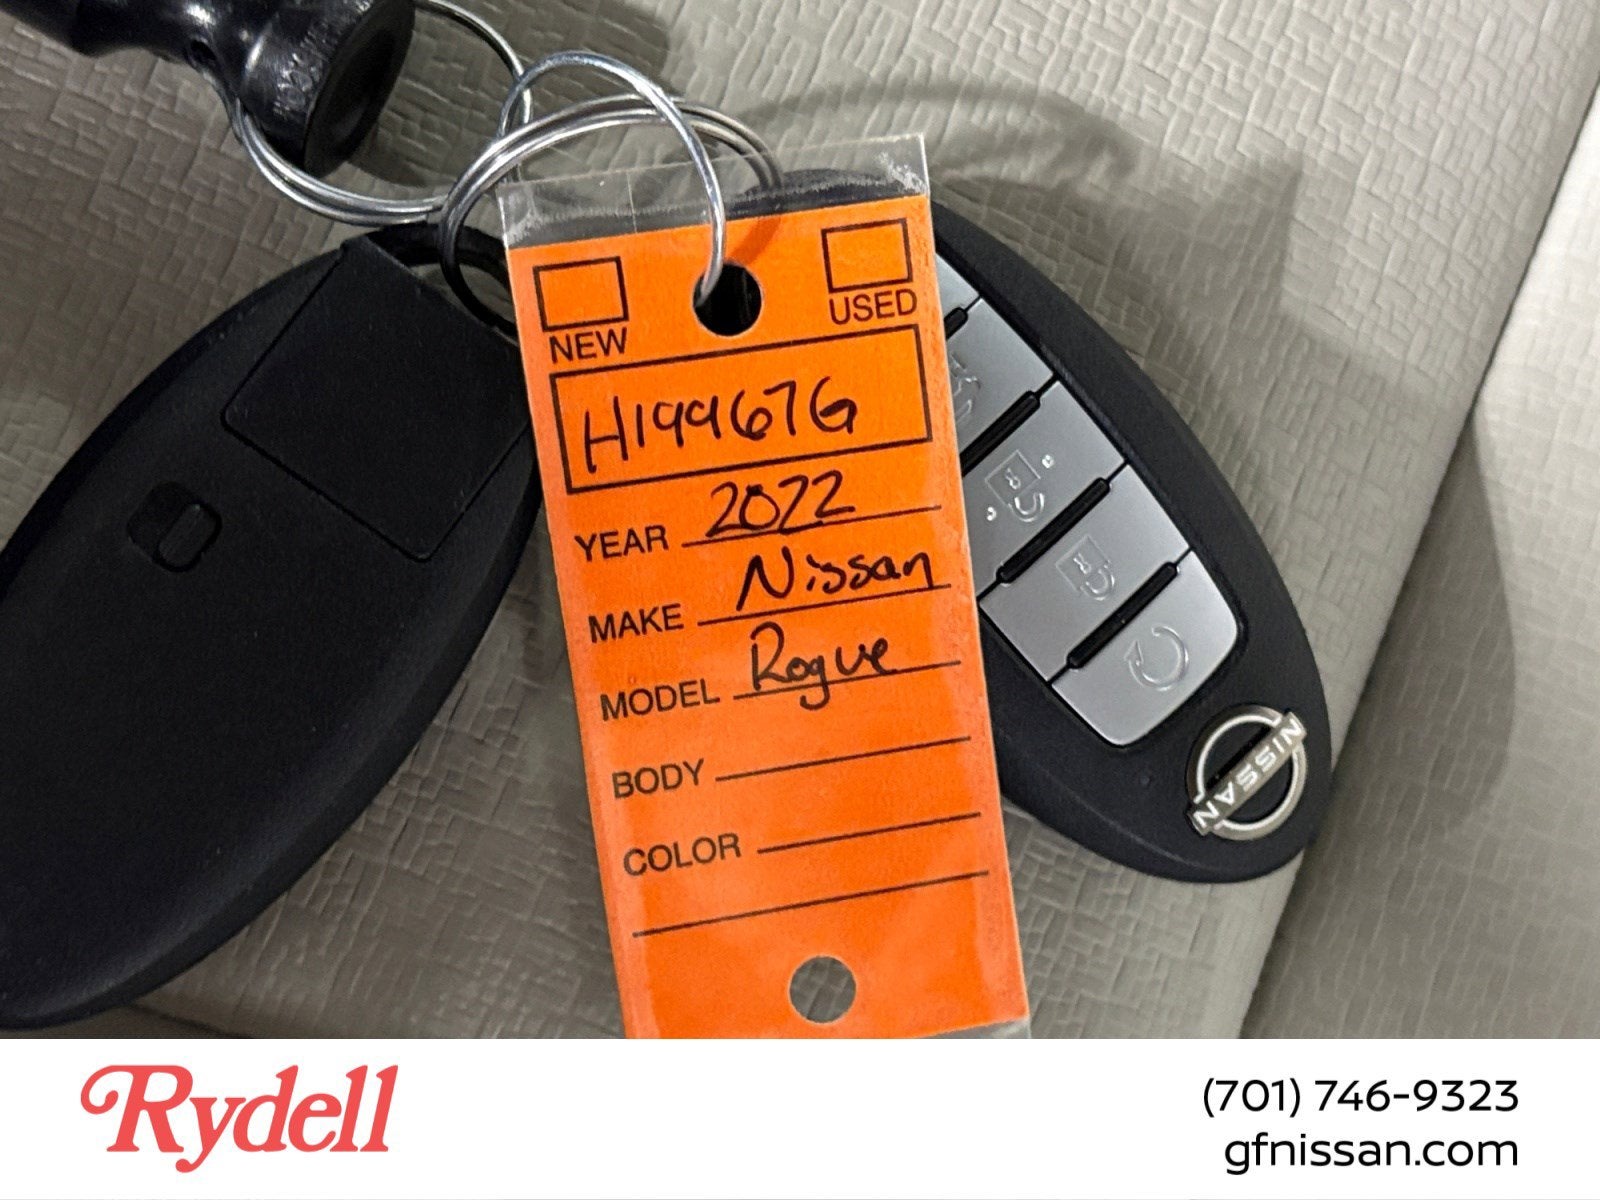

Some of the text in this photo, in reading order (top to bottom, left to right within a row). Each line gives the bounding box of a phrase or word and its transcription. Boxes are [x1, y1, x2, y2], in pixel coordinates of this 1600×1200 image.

[829, 288, 918, 325] USED
[549, 327, 628, 364] NEW
[583, 376, 858, 473] H19967G
[705, 470, 856, 537] 2022
[574, 524, 669, 562] YEAR
[736, 546, 935, 611] Nissan
[588, 603, 685, 643] MAKE
[750, 621, 897, 710] Rogue
[600, 678, 720, 721] MODEL
[612, 758, 704, 799] BODY
[1193, 717, 1302, 829] NISSAN
[623, 832, 741, 877] COLOR
